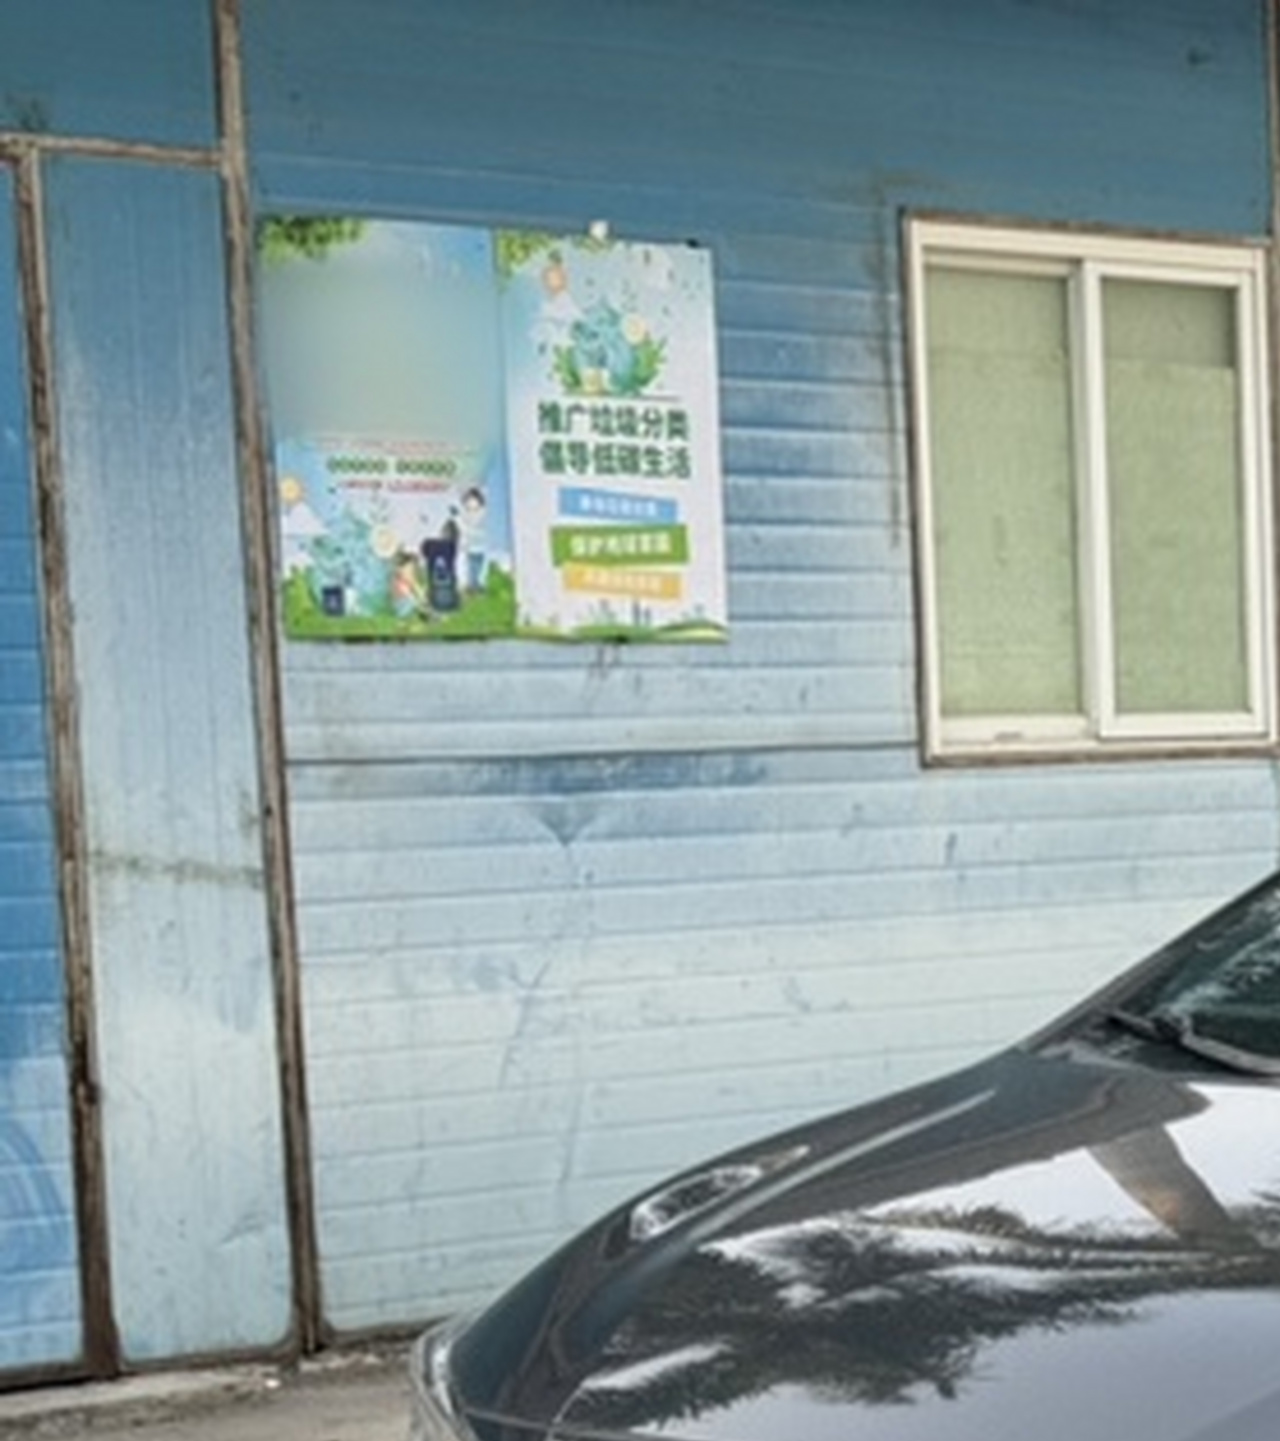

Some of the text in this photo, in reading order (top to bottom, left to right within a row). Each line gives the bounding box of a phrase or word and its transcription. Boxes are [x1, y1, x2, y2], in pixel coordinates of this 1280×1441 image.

[537, 401, 688, 441] 推广垃圾分类
[538, 441, 691, 480] 倡导低碳生活
